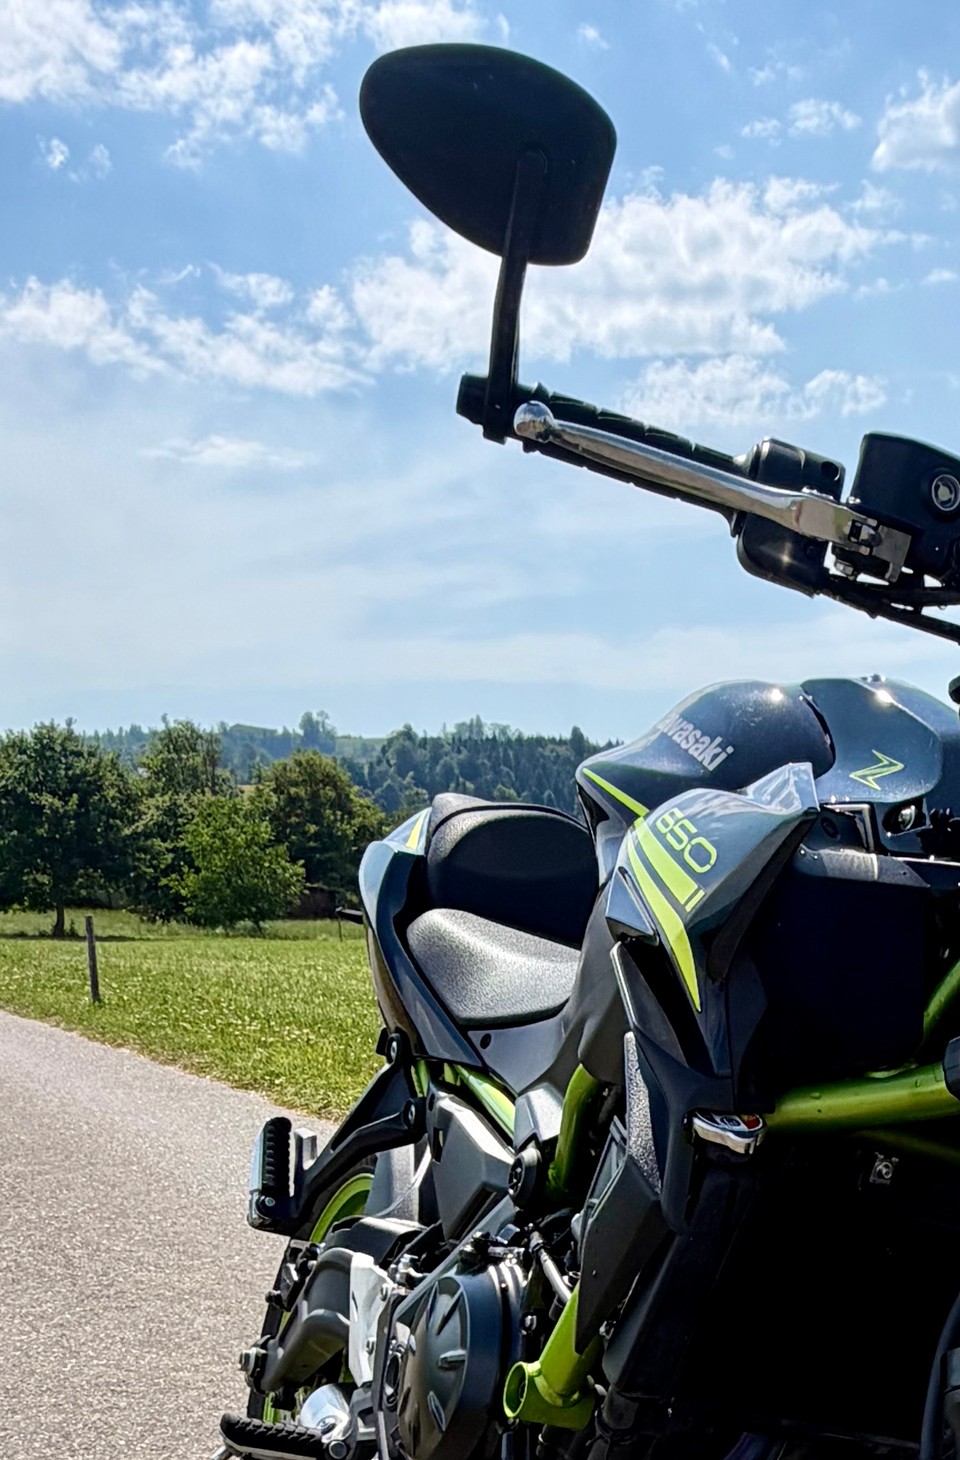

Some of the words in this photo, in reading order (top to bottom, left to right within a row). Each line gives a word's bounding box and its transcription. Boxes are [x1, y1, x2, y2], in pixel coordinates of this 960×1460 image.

[657, 713, 734, 772] wasaki
[849, 749, 905, 791] Z
[656, 808, 718, 874] 650
